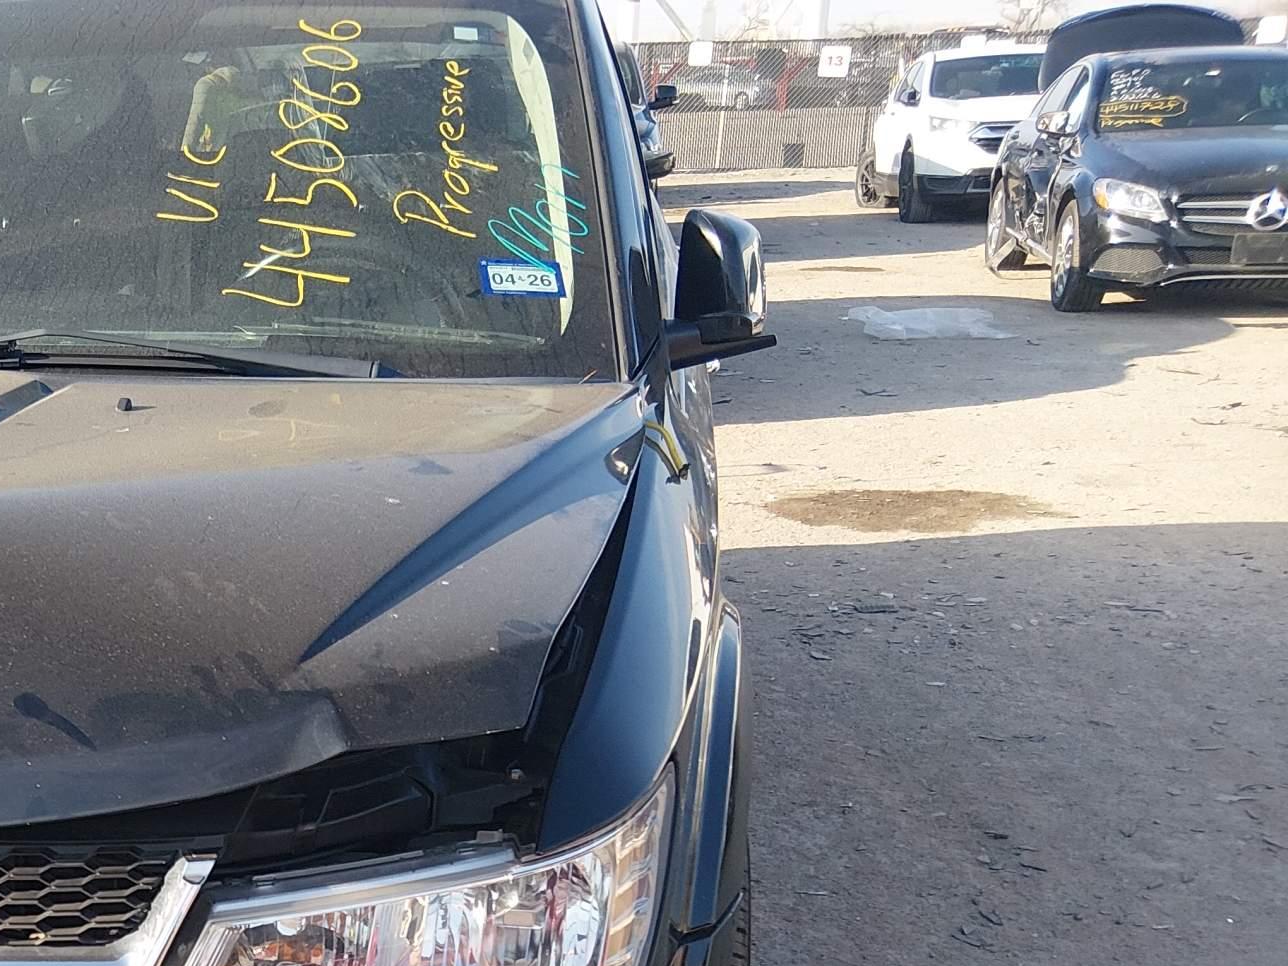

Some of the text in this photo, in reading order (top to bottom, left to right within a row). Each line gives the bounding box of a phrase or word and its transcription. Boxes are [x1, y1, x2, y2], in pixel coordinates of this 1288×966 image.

[392, 59, 499, 239] Progressive
[827, 56, 844, 66] 13
[221, 18, 362, 308] 44508606
